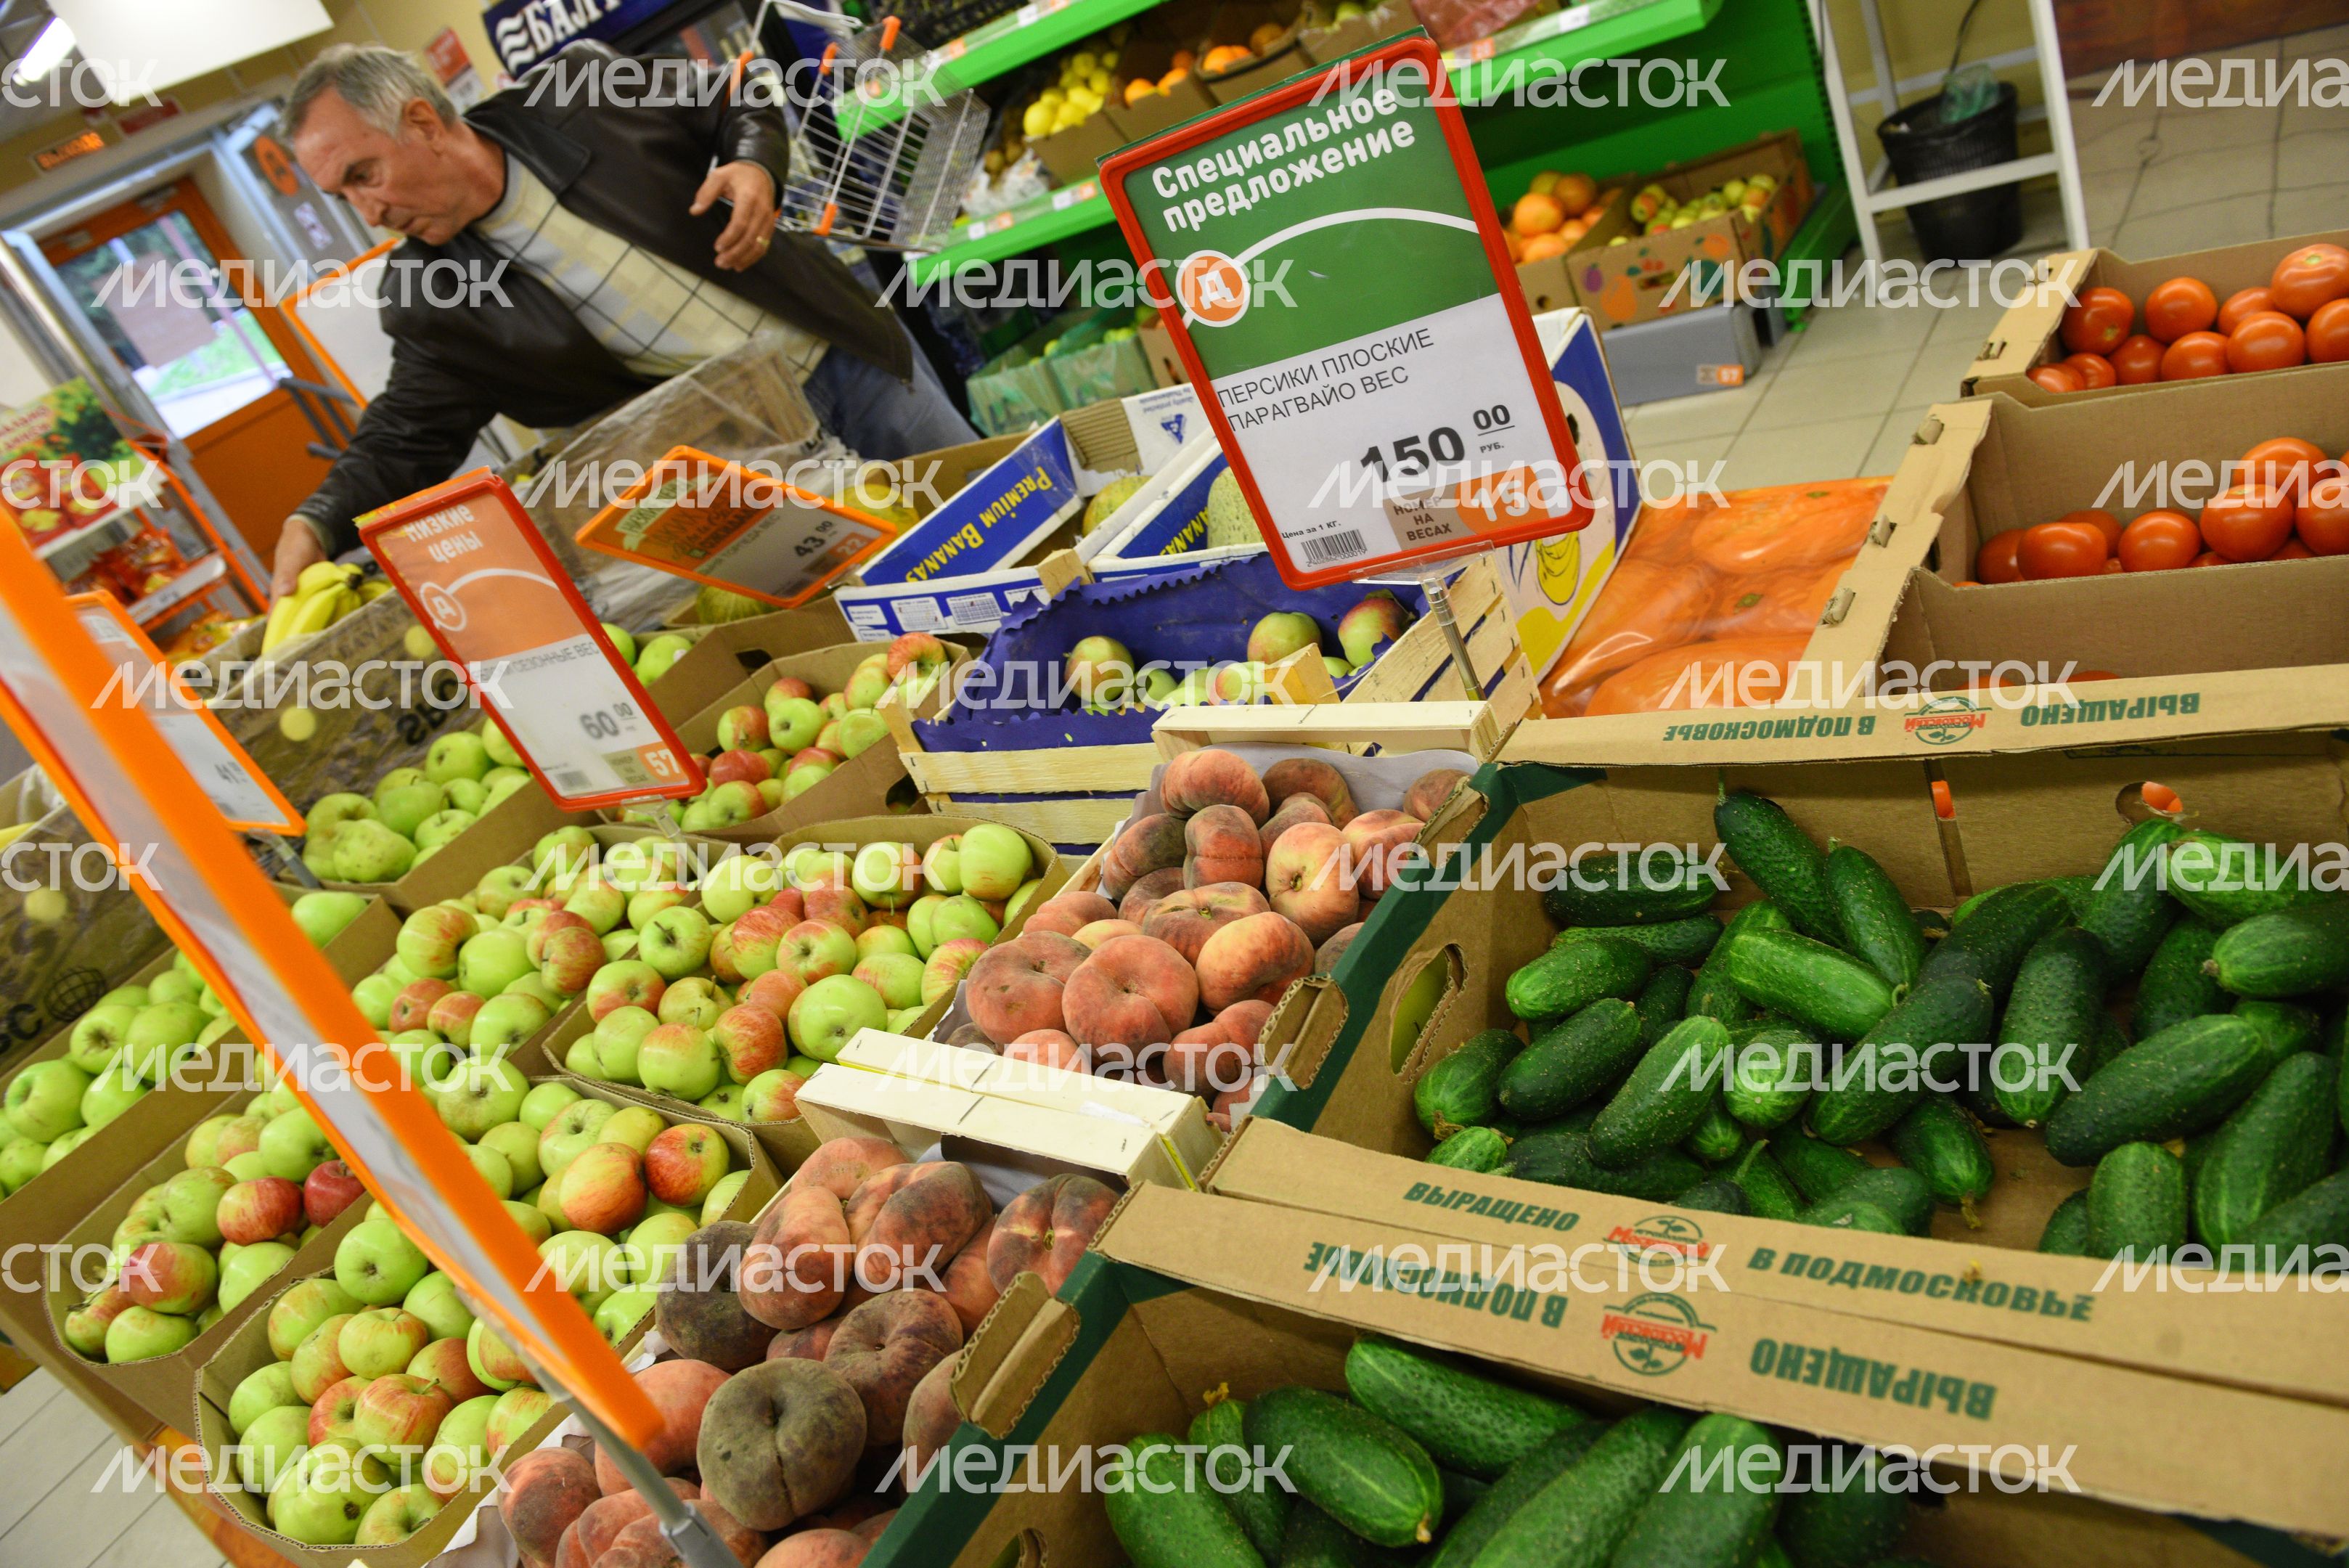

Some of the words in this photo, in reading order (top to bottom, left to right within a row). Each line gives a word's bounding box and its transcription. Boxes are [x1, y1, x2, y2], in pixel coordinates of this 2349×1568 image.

[525, 0, 621, 53] БАЛ
[1152, 89, 1397, 198] Специальное
[1164, 121, 1415, 232] предложение
[1217, 364, 1318, 407] ПЕРСИКИ
[1322, 328, 1434, 377] ПЛОСКИЕ
[1227, 383, 1355, 431] ПАРАГВАЙО
[1360, 367, 1409, 394] ВЕС
[1360, 427, 1465, 482] 150
[1473, 404, 1511, 430] 00
[1281, 530, 1304, 539] Цена
[1406, 523, 1452, 541] ВЕСАХ
[1413, 513, 1434, 525] НА
[428, 531, 483, 563] цены
[793, 536, 825, 557] 43
[579, 711, 620, 740] 60
[1858, 715, 1876, 736] В
[2020, 693, 2200, 727] ВЫРАЩЕНО
[1662, 715, 1852, 742] ПОДМОСКОВЬЕ
[645, 748, 680, 777] 57
[1402, 1182, 1581, 1232] ВЫРАЩЕНО
[1747, 1247, 1778, 1271] В
[1304, 1241, 1539, 1322] ПОДМОСКОВЬЕ
[1541, 1292, 1569, 1328] В
[1750, 1338, 1998, 1421] ВЫРАЩЕНО
